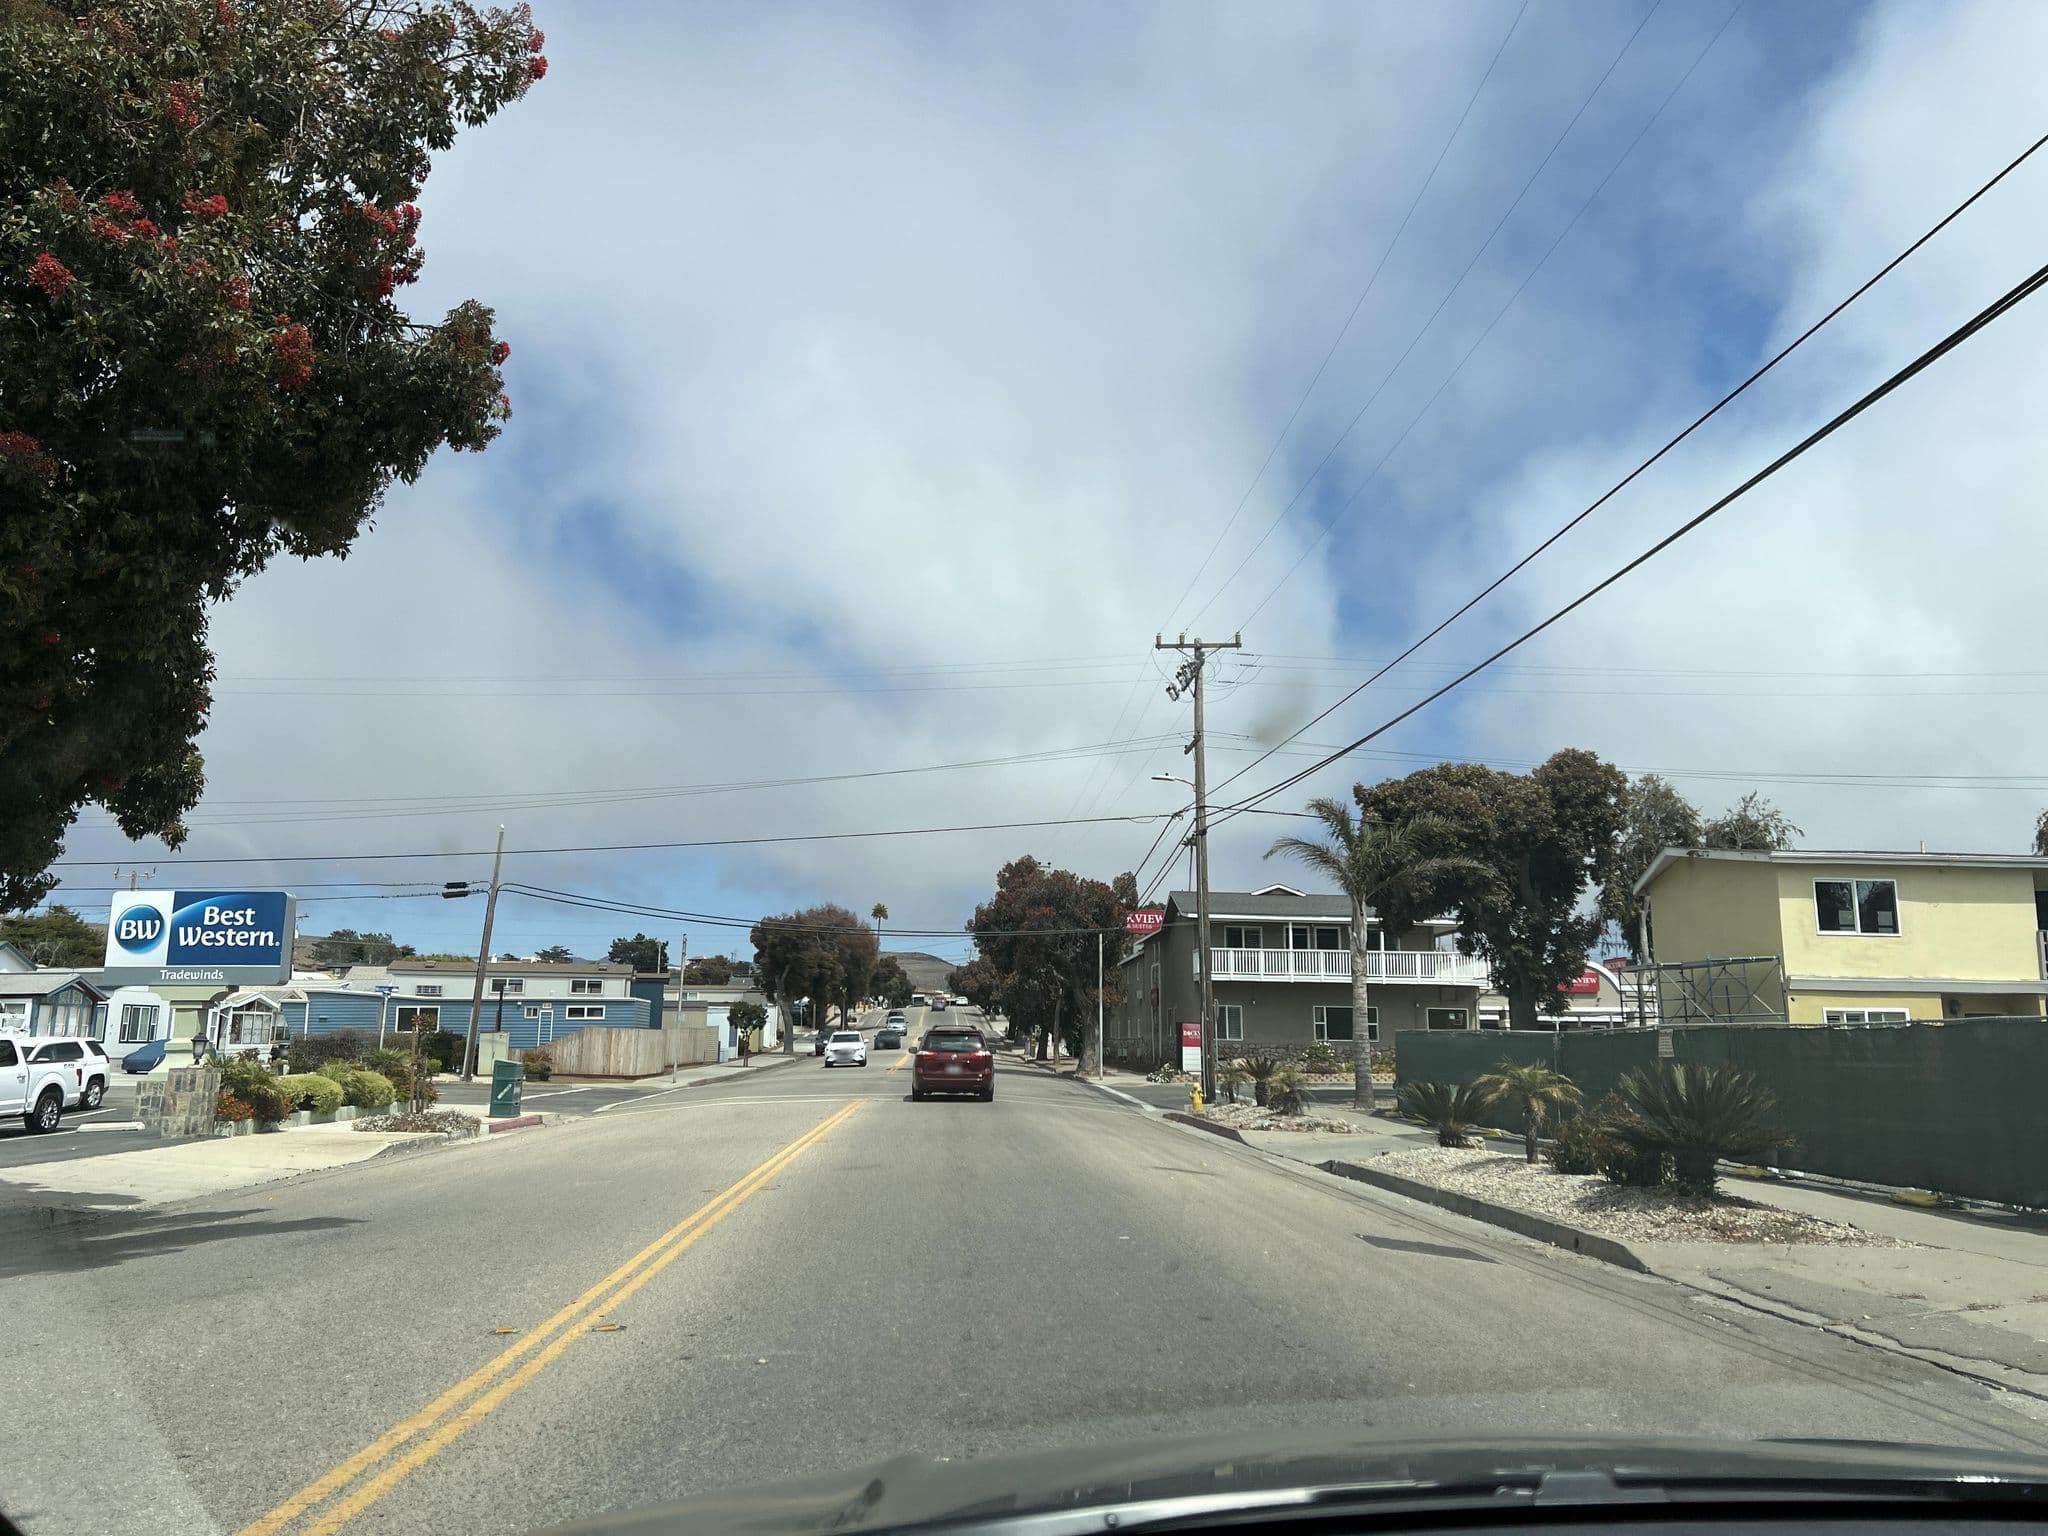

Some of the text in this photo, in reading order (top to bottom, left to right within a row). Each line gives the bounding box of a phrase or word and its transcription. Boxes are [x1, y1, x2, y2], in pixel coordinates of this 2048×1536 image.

[204, 906, 256, 926] Best
[120, 919, 161, 940] BW
[160, 969, 224, 980] Tradewinds
